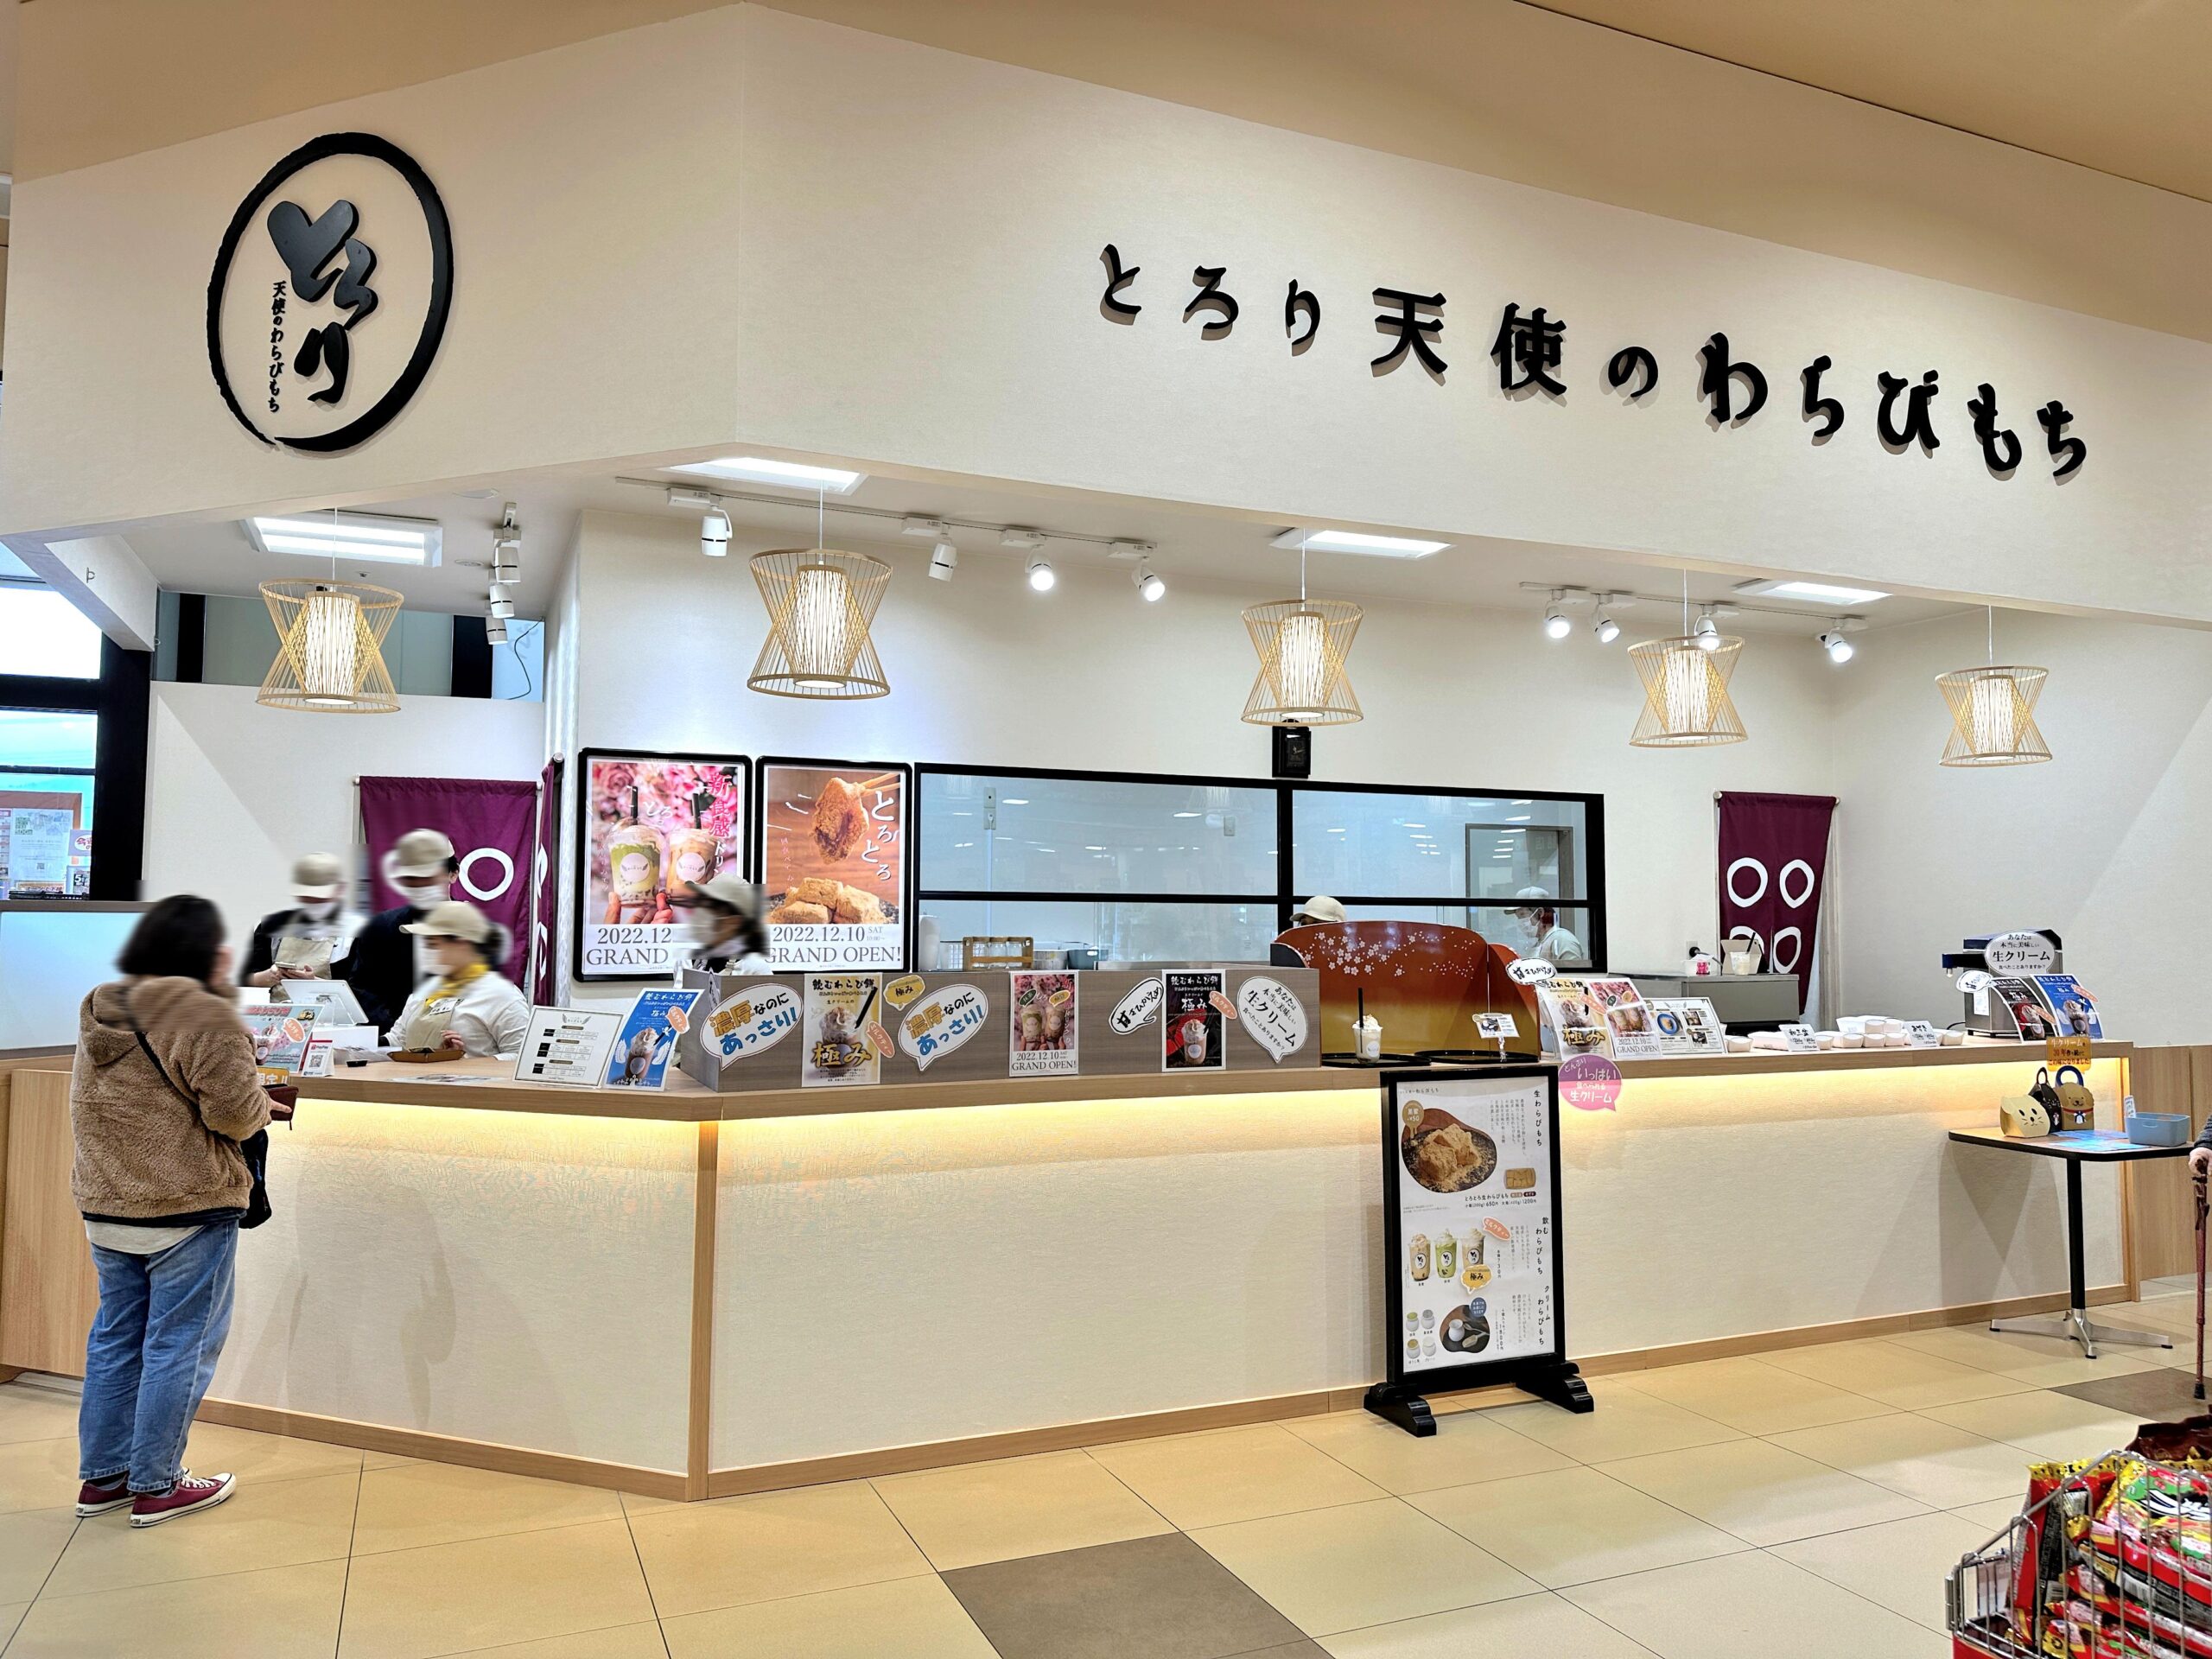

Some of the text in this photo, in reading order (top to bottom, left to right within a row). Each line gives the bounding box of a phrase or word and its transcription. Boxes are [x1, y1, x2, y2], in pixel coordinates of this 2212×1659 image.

[268, 281, 287, 413] 天使のわらびもち
[1103, 244, 2088, 479] とろり天使のわらびもち
[772, 925, 884, 943] 2022.12.10 SAT
[586, 948, 669, 966] GRAND
[843, 945, 902, 962] OPEN!
[1992, 950, 2051, 963] 生クリーム
[812, 978, 875, 991] 飲むわらび餅
[1116, 986, 1162, 1029] 甘さひかえめ
[1181, 997, 1208, 1012] 極み
[1262, 988, 1297, 1026] 本当に美味しい
[1274, 986, 1297, 1011] あなたは
[709, 992, 790, 1038] 濃厚なのに
[906, 991, 976, 1039] 濃厚なのに
[1244, 989, 1297, 1048] 生クリーム
[1563, 1025, 1605, 1046] 極み
[811, 1041, 873, 1069] 極み
[1012, 1059, 1077, 1071] GRAND OPEN!
[1016, 1051, 1060, 1061] 2022.12.10
[1570, 1090, 1612, 1103] 生クリーム
[1534, 1090, 1542, 1147] 生わらびもち
[1541, 1217, 1549, 1235] 飲む
